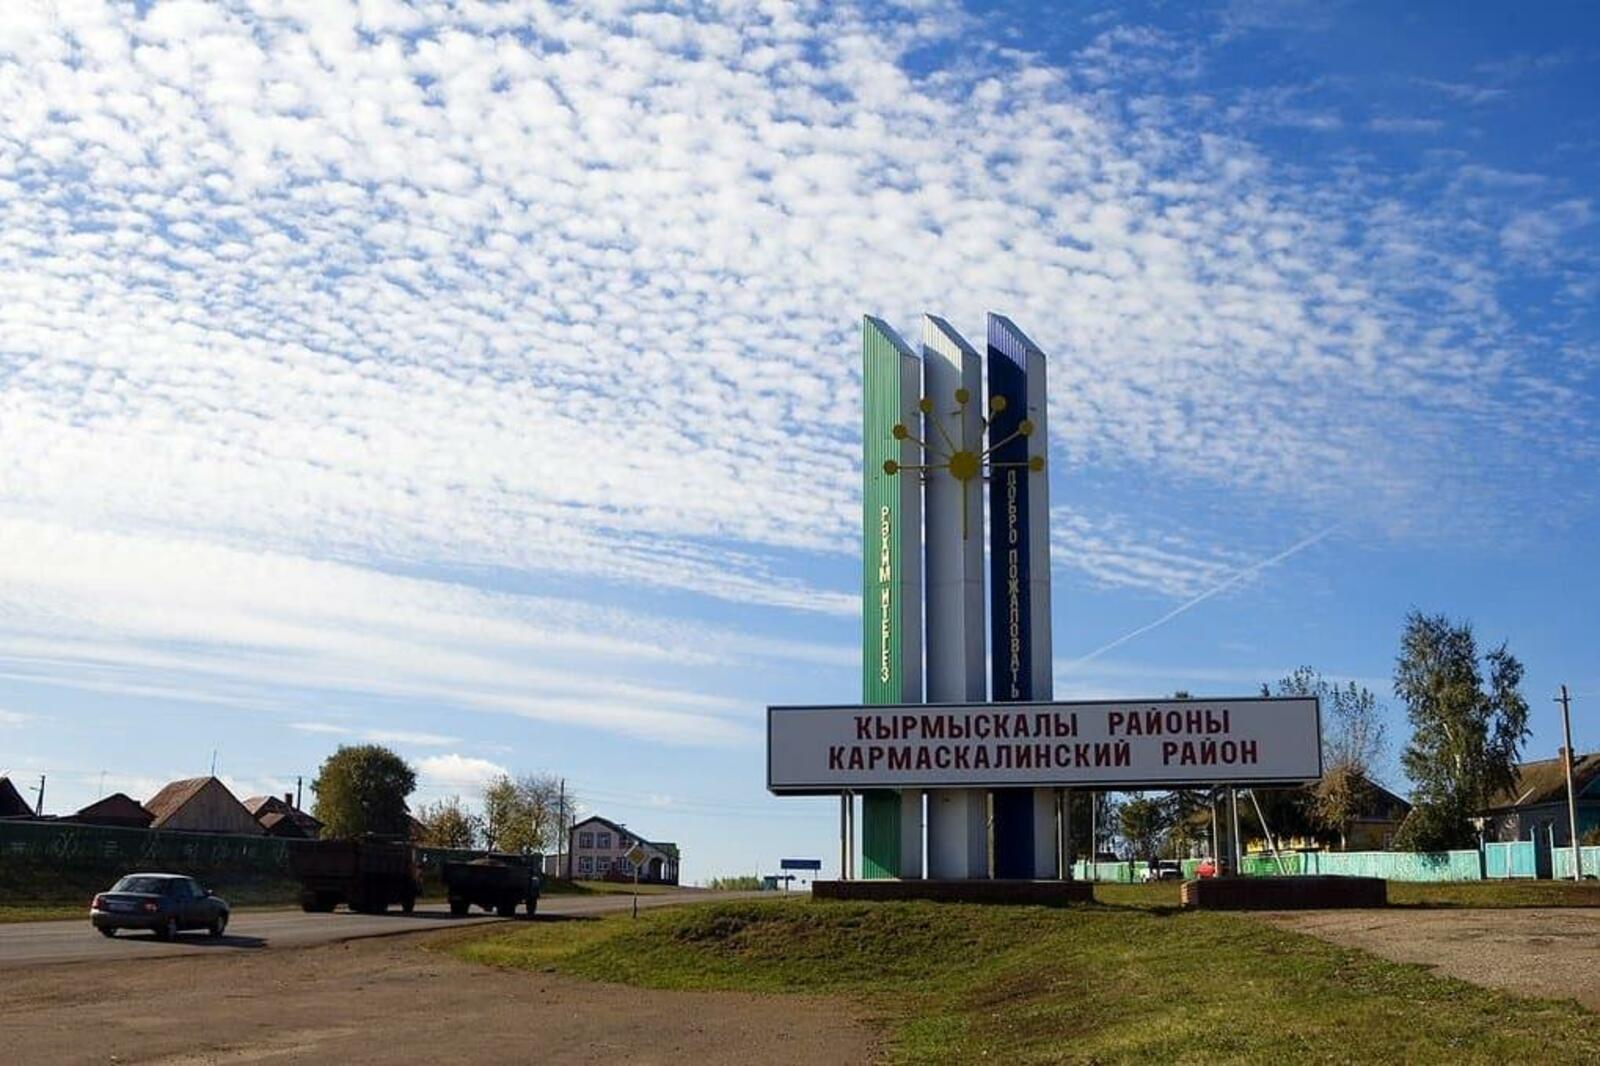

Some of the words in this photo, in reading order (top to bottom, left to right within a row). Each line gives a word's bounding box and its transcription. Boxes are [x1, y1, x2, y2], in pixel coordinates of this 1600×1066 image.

[1007, 468, 1018, 544] ДОБРО
[1008, 549, 1020, 699] ПОЖАЛОВАТЬ
[1108, 707, 1231, 736] РАЙОНЫ
[828, 739, 1132, 770] КАРМАСКАЛИНСКИЙ
[1162, 737, 1258, 766] РАЙОН
